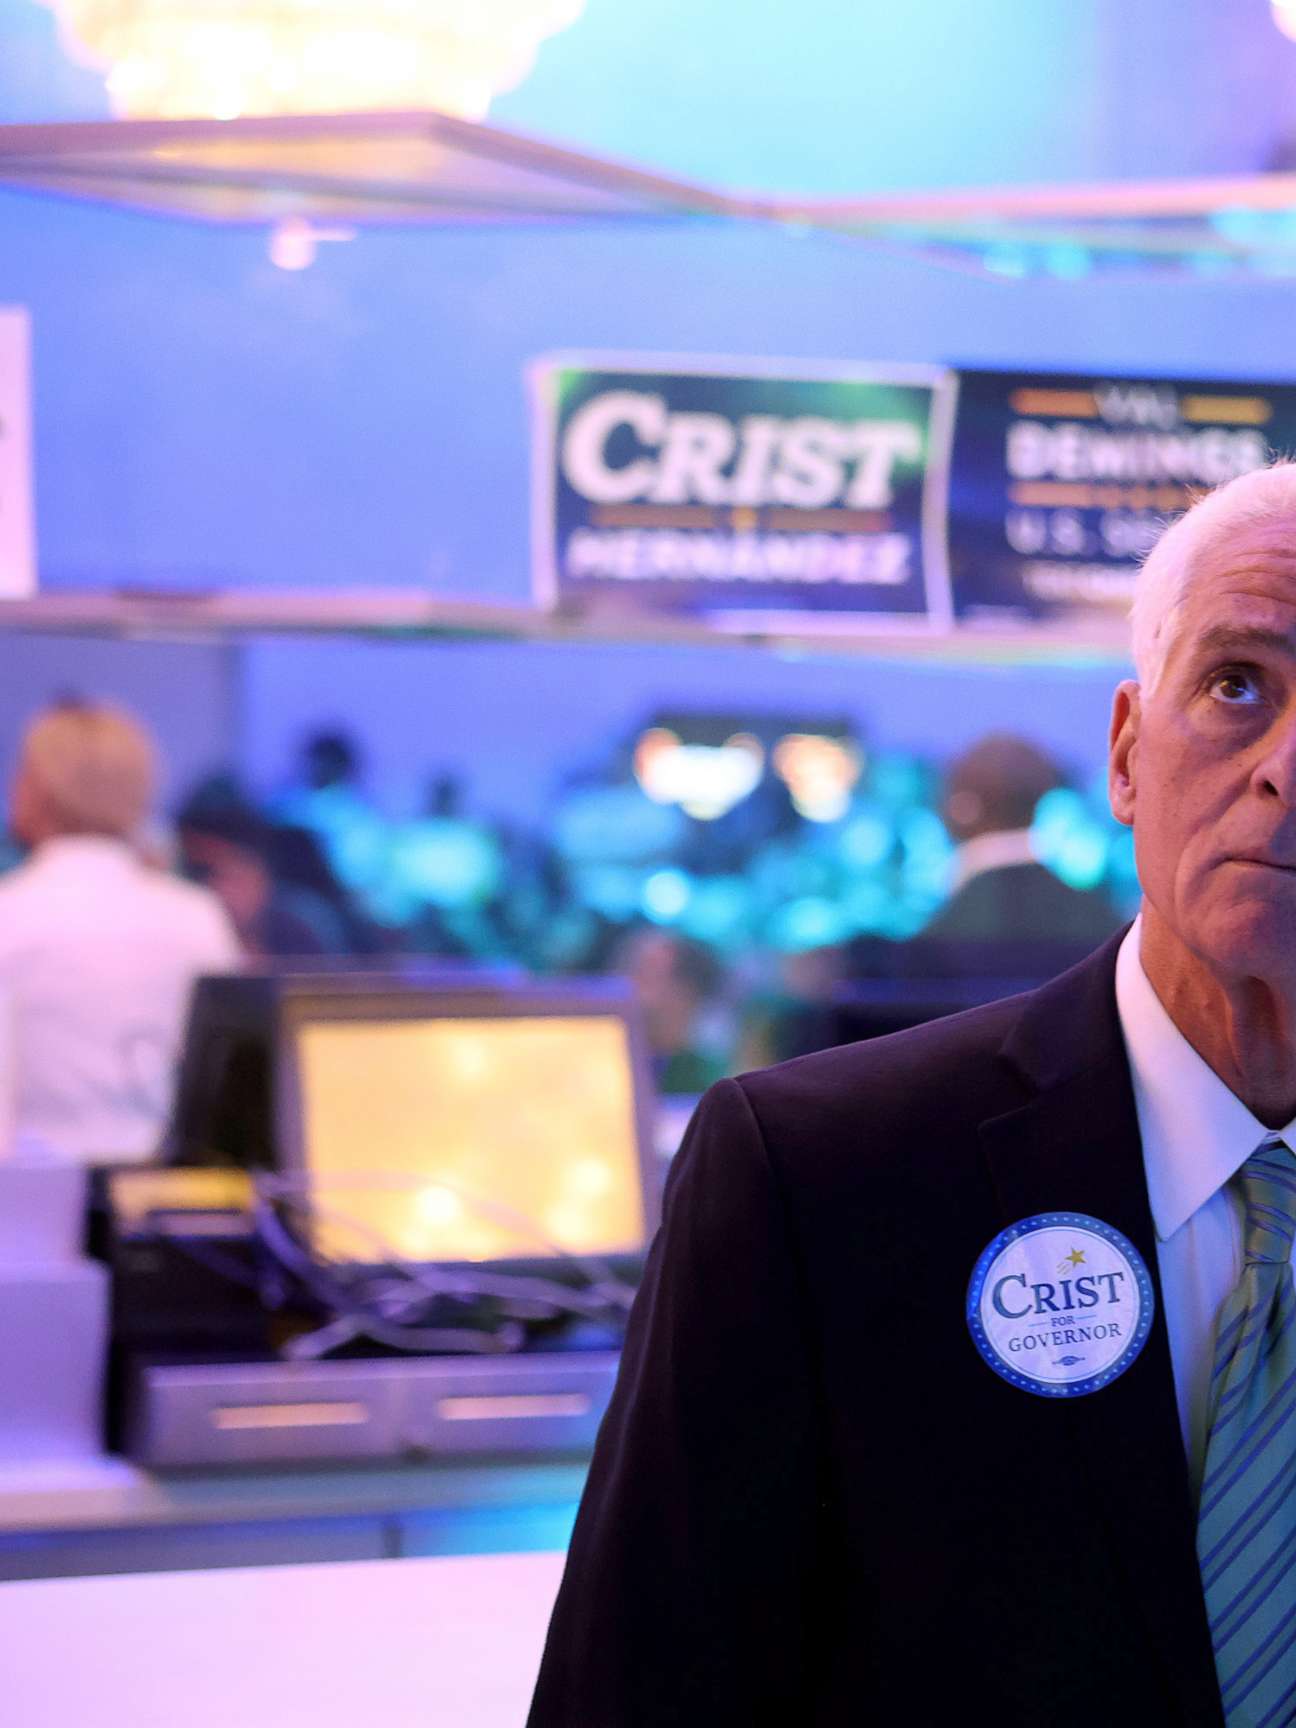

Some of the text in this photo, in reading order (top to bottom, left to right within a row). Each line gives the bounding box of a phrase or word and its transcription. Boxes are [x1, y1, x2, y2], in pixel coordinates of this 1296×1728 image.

[563, 391, 922, 508] CRIST
[1006, 420, 1266, 484] DEMINGS
[992, 1272, 1125, 1319] CRIST
[1008, 1323, 1122, 1352] GOVERNOR
[1051, 1315, 1075, 1327] FOR
